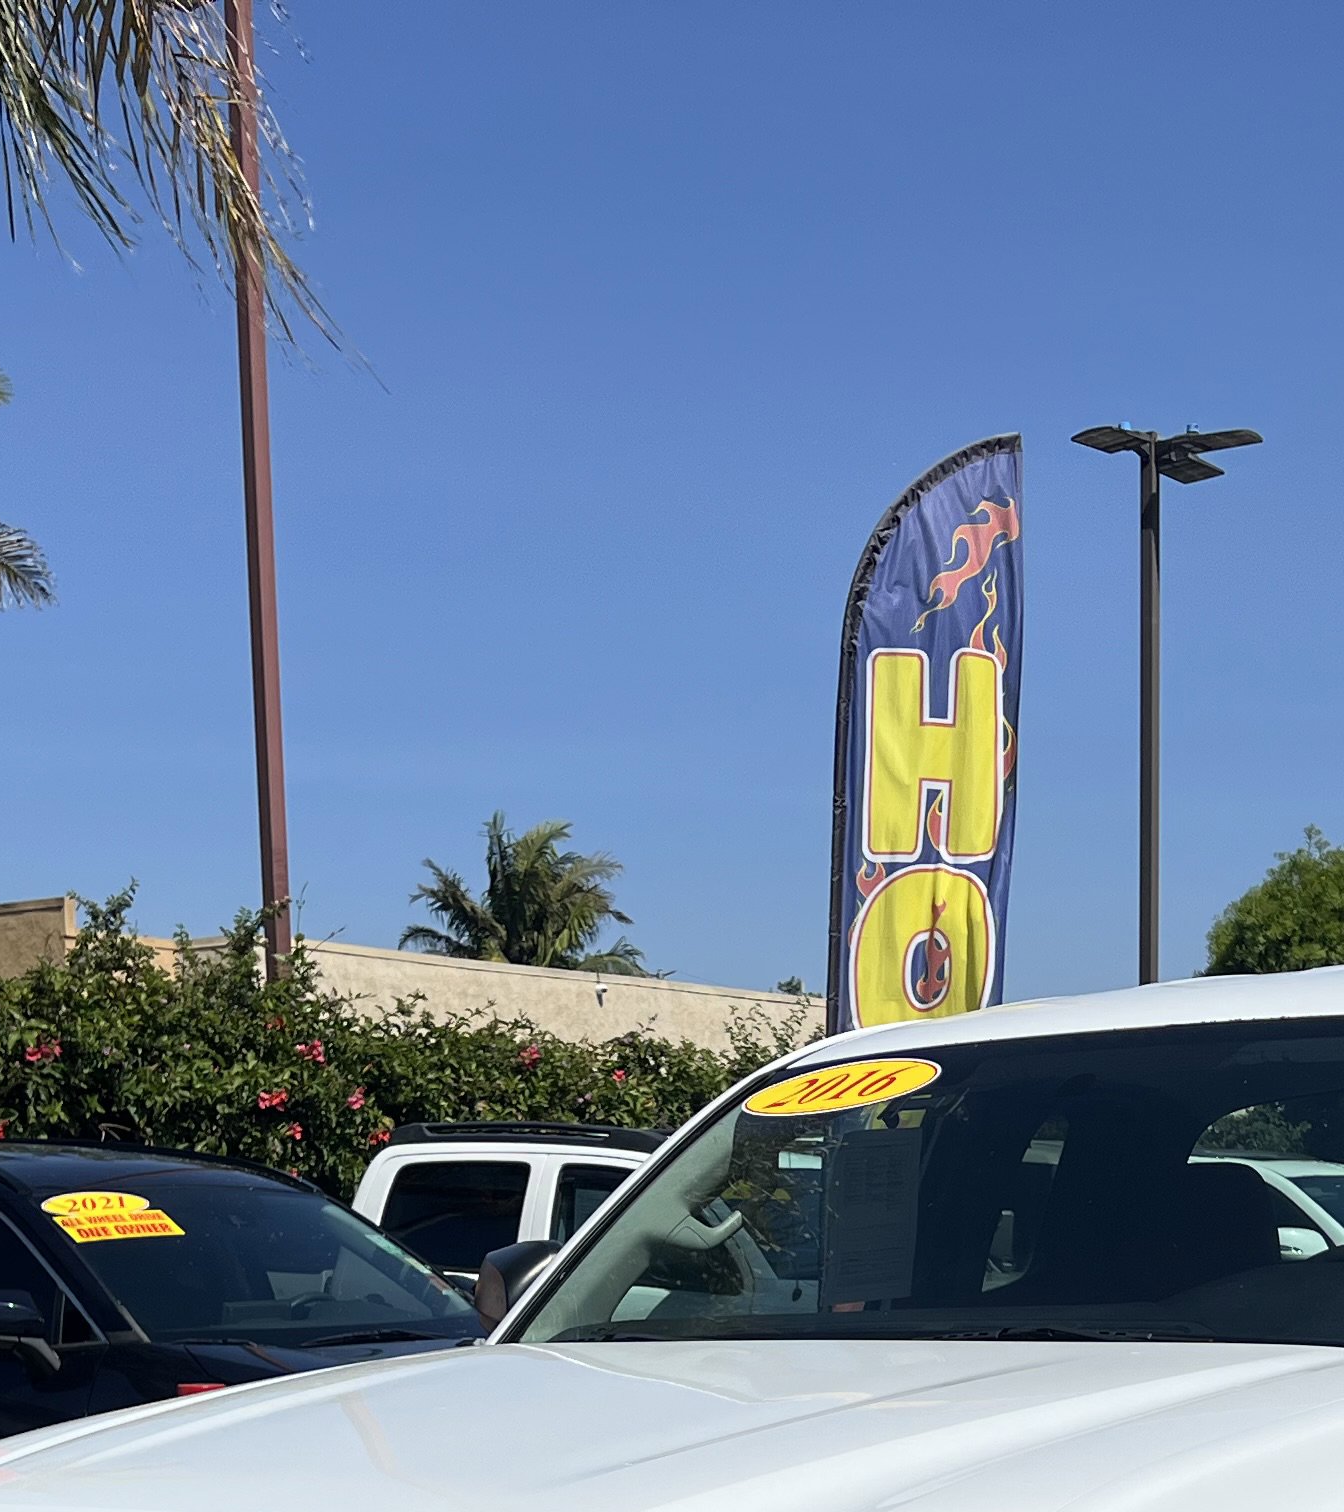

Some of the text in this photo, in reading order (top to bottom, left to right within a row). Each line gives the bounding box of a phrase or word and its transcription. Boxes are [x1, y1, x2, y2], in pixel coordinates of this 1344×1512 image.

[761, 1064, 920, 1110] 2016
[63, 1196, 126, 1213] 2021
[76, 1223, 173, 1239] ONE OWNER
